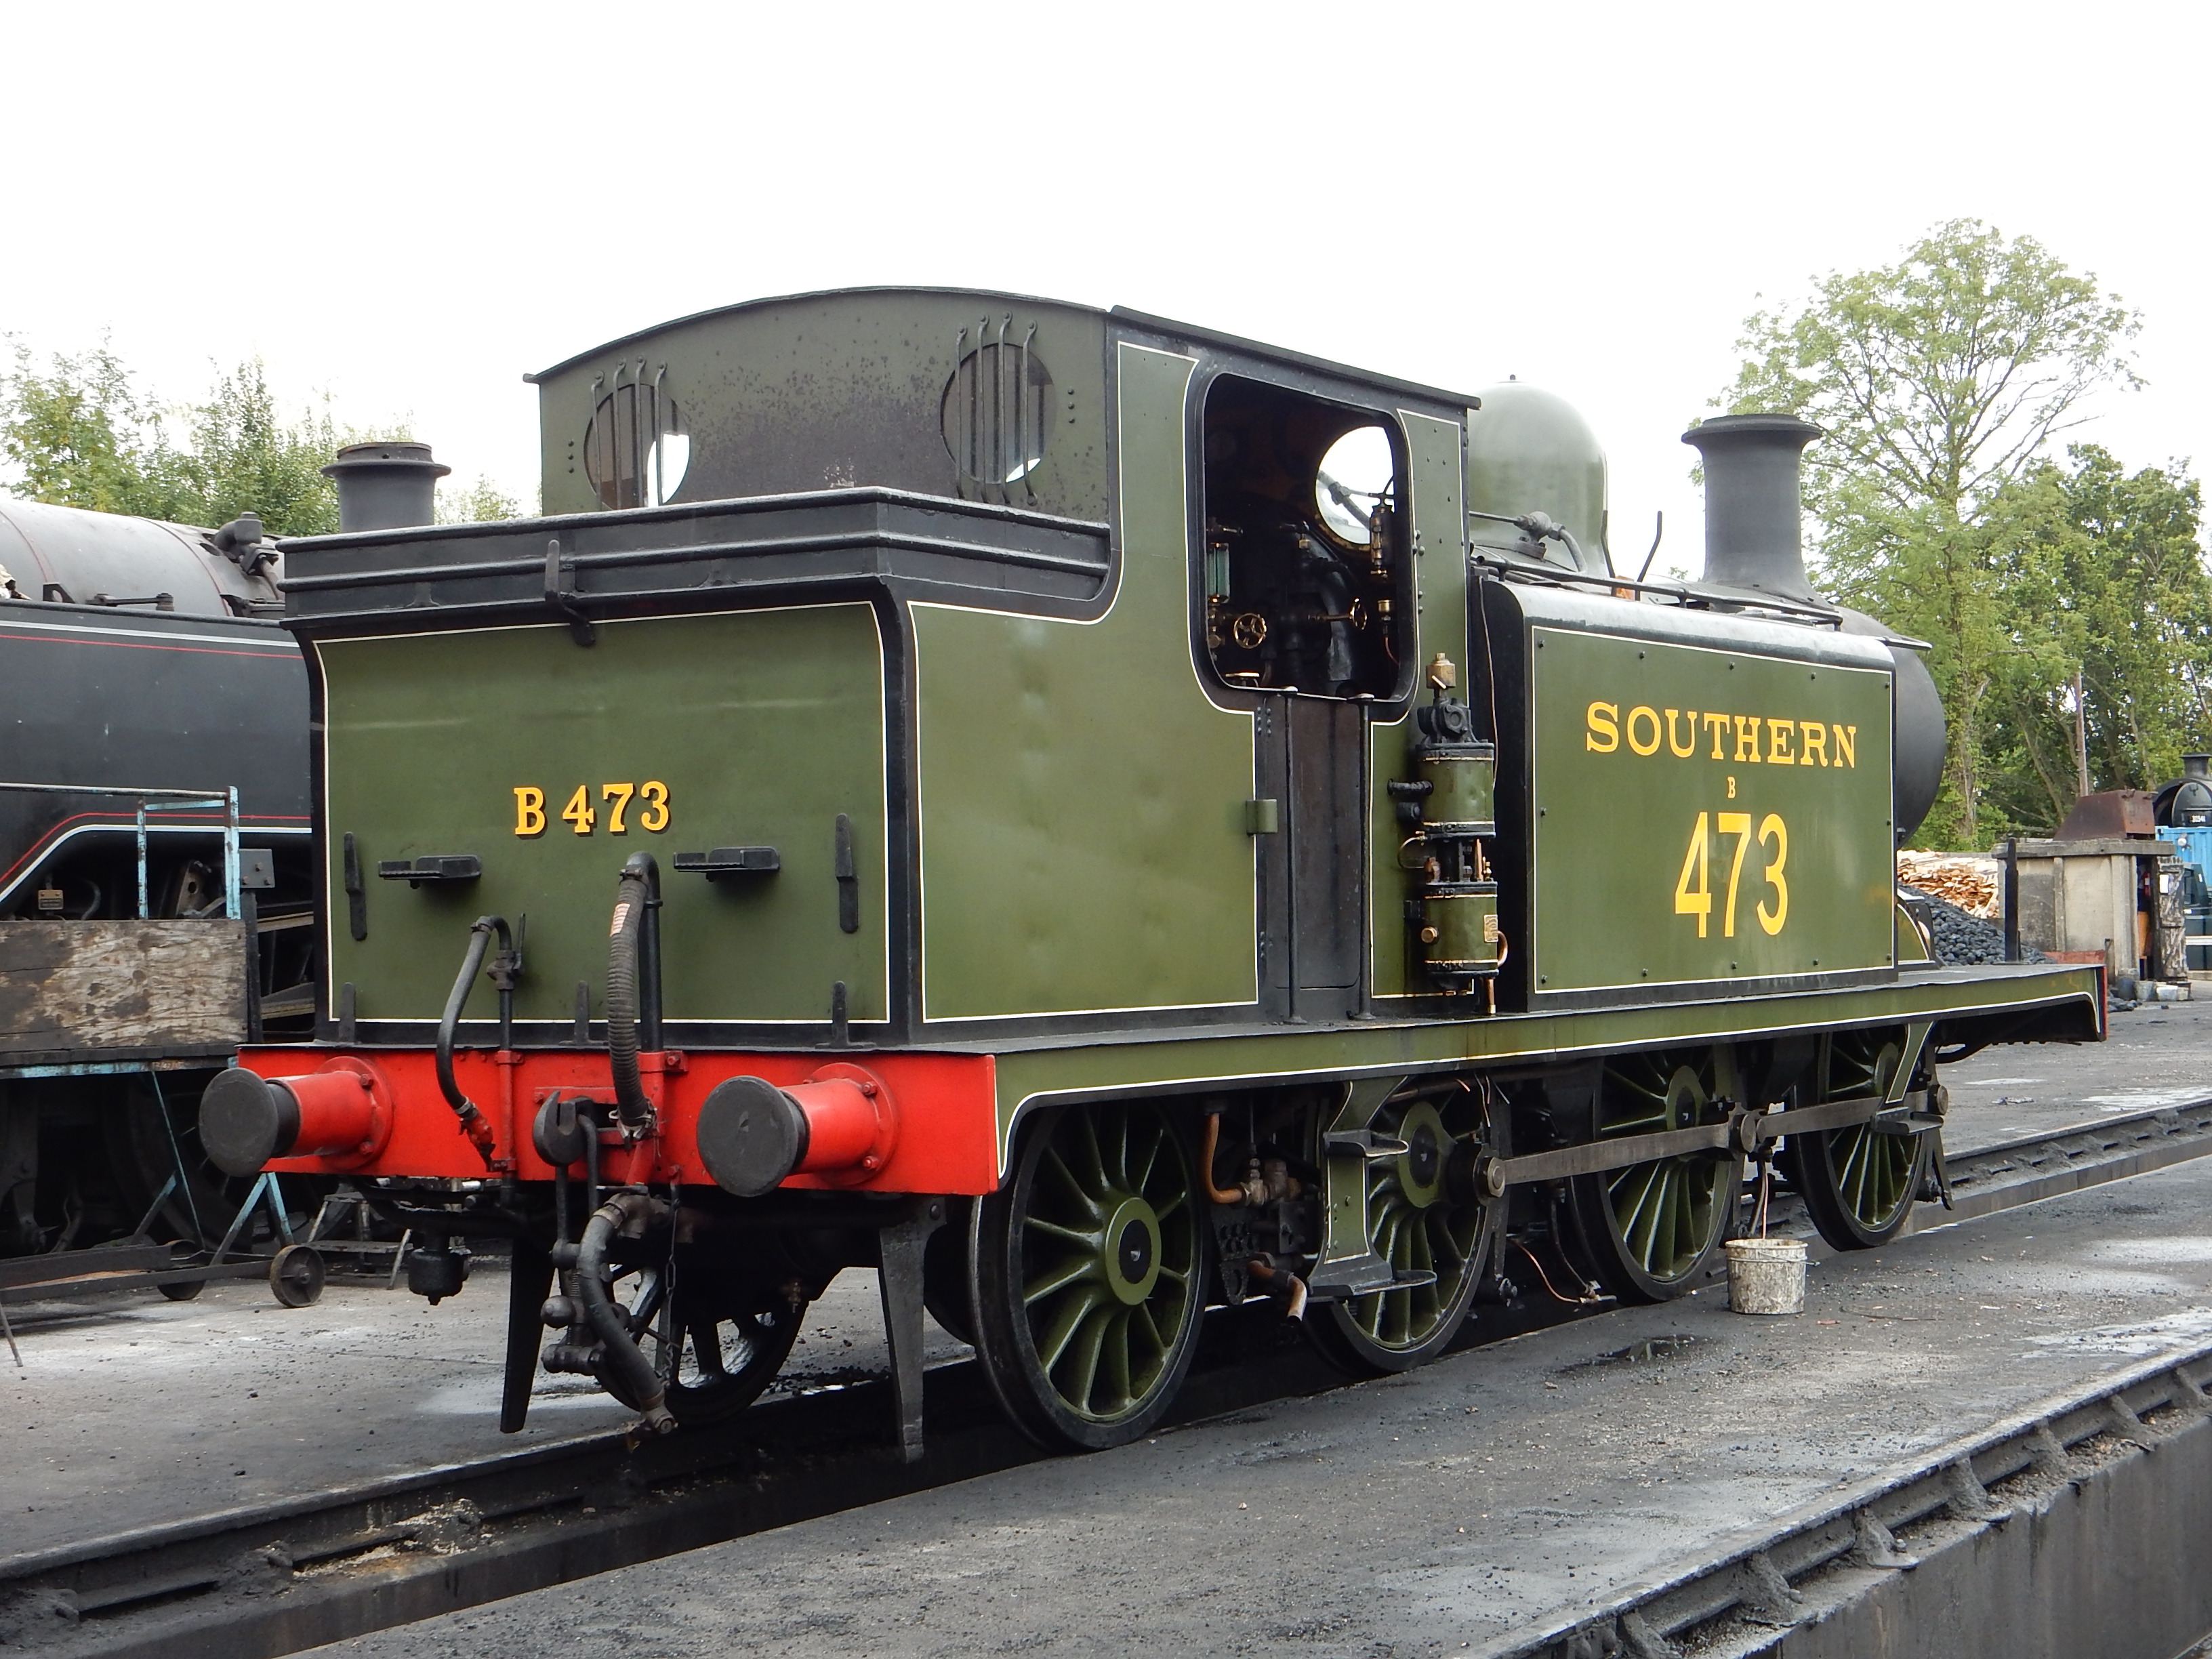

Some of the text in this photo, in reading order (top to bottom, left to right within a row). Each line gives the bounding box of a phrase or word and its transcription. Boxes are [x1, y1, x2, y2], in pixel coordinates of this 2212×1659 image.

[1586, 701, 1857, 767] SOUTHERN
[514, 780, 670, 835] B 473
[1727, 776, 1736, 798] B
[1675, 811, 1788, 938] 473
